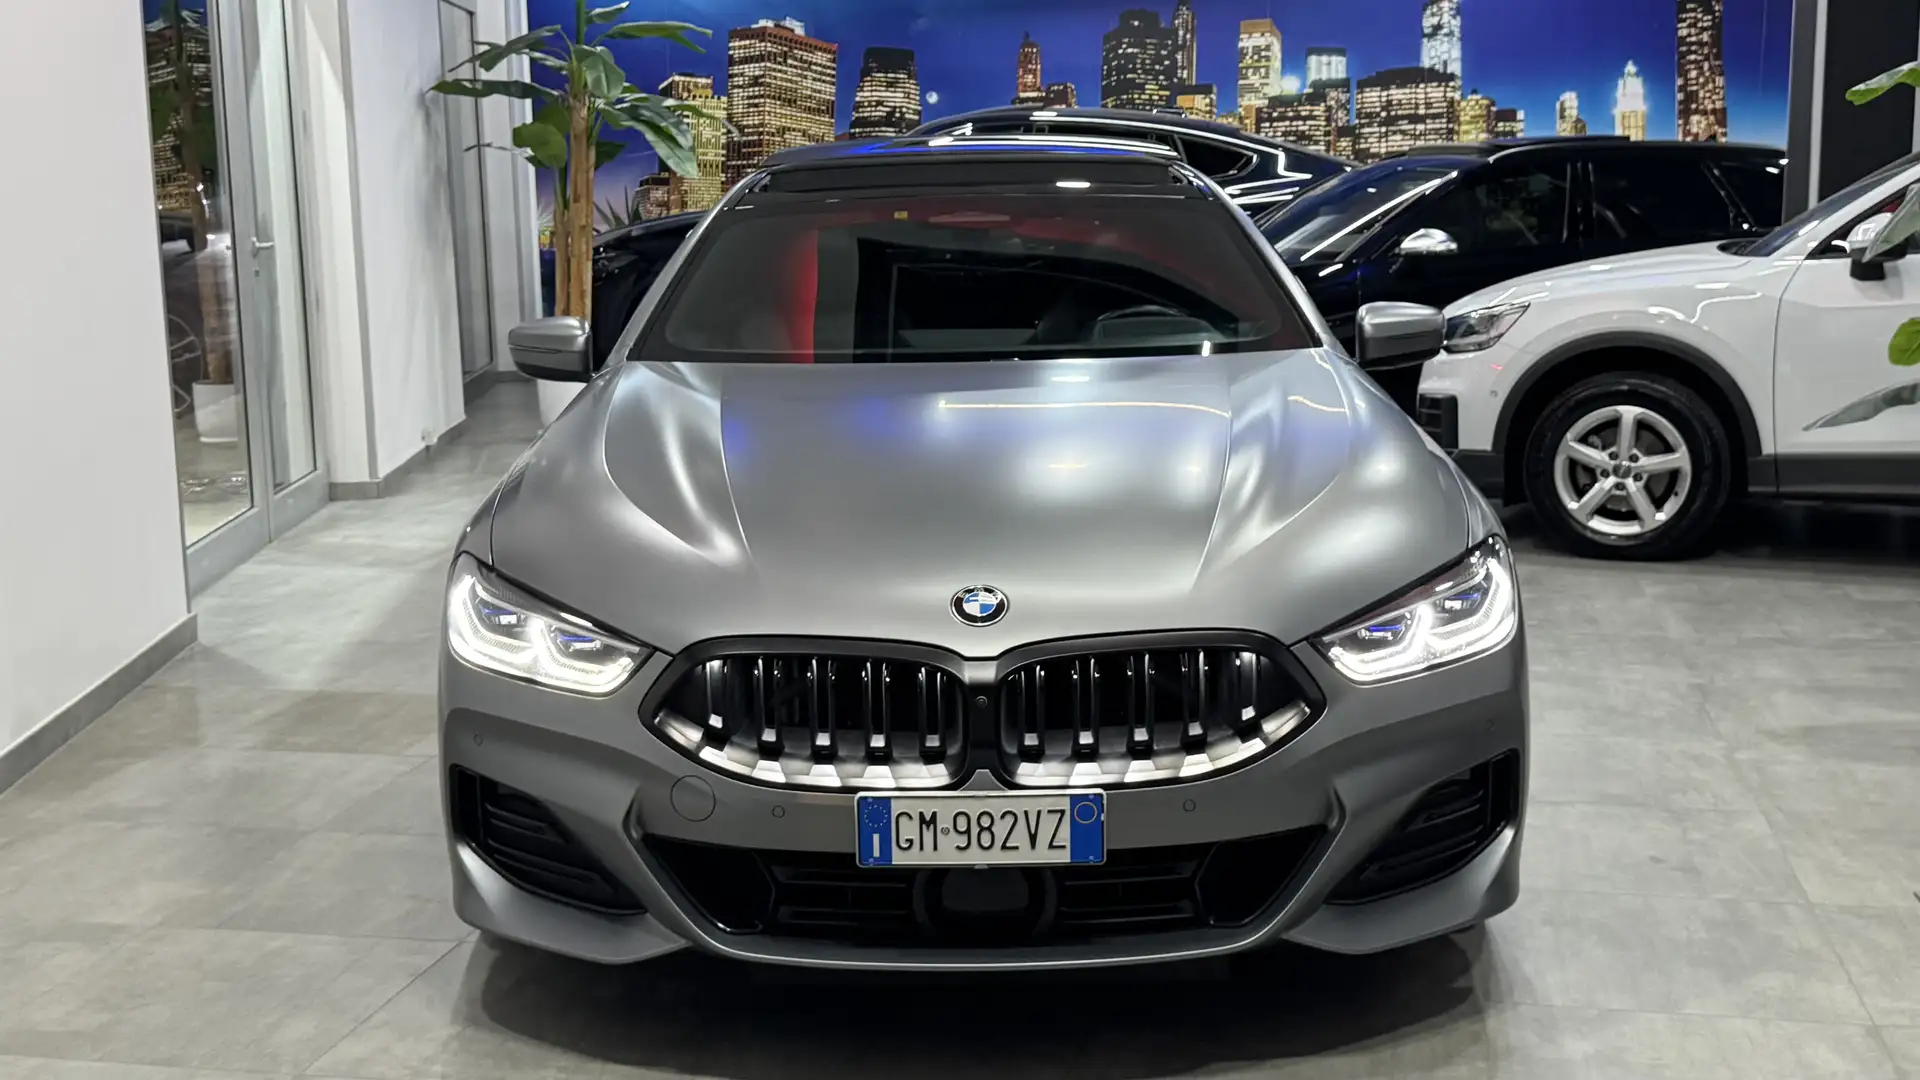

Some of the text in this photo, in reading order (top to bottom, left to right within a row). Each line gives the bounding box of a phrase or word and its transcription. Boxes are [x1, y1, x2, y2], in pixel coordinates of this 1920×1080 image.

[872, 833, 880, 857] I
[894, 809, 1067, 851] GM 982VZ
